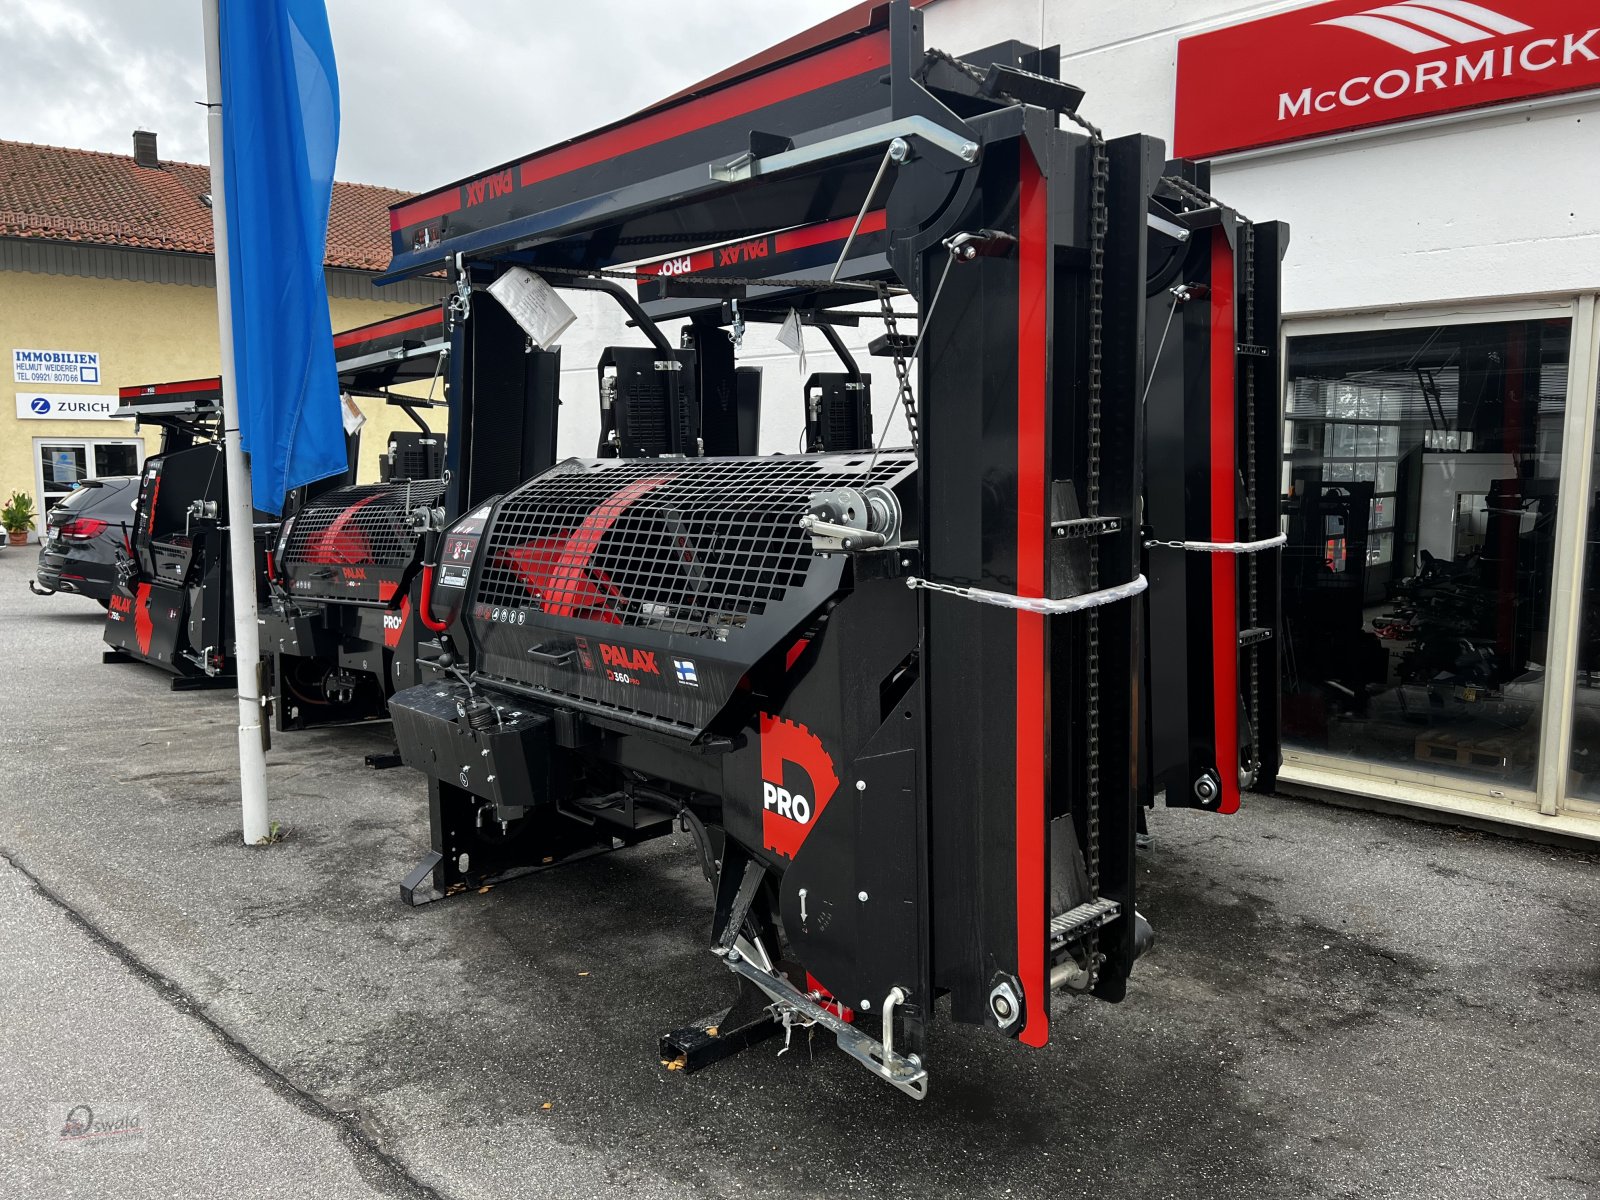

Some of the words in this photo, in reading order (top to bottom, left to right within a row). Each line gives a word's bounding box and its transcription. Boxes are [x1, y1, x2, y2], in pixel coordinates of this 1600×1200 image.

[466, 168, 513, 208] PALAX
[719, 237, 769, 267] PALAX
[15, 351, 97, 365] IMMOBILIEN
[16, 363, 43, 372] HELMUT
[44, 364, 78, 373] WEIDERER
[57, 402, 110, 412] ZURICH
[599, 643, 660, 675] PALAX
[763, 781, 810, 825] PRO
